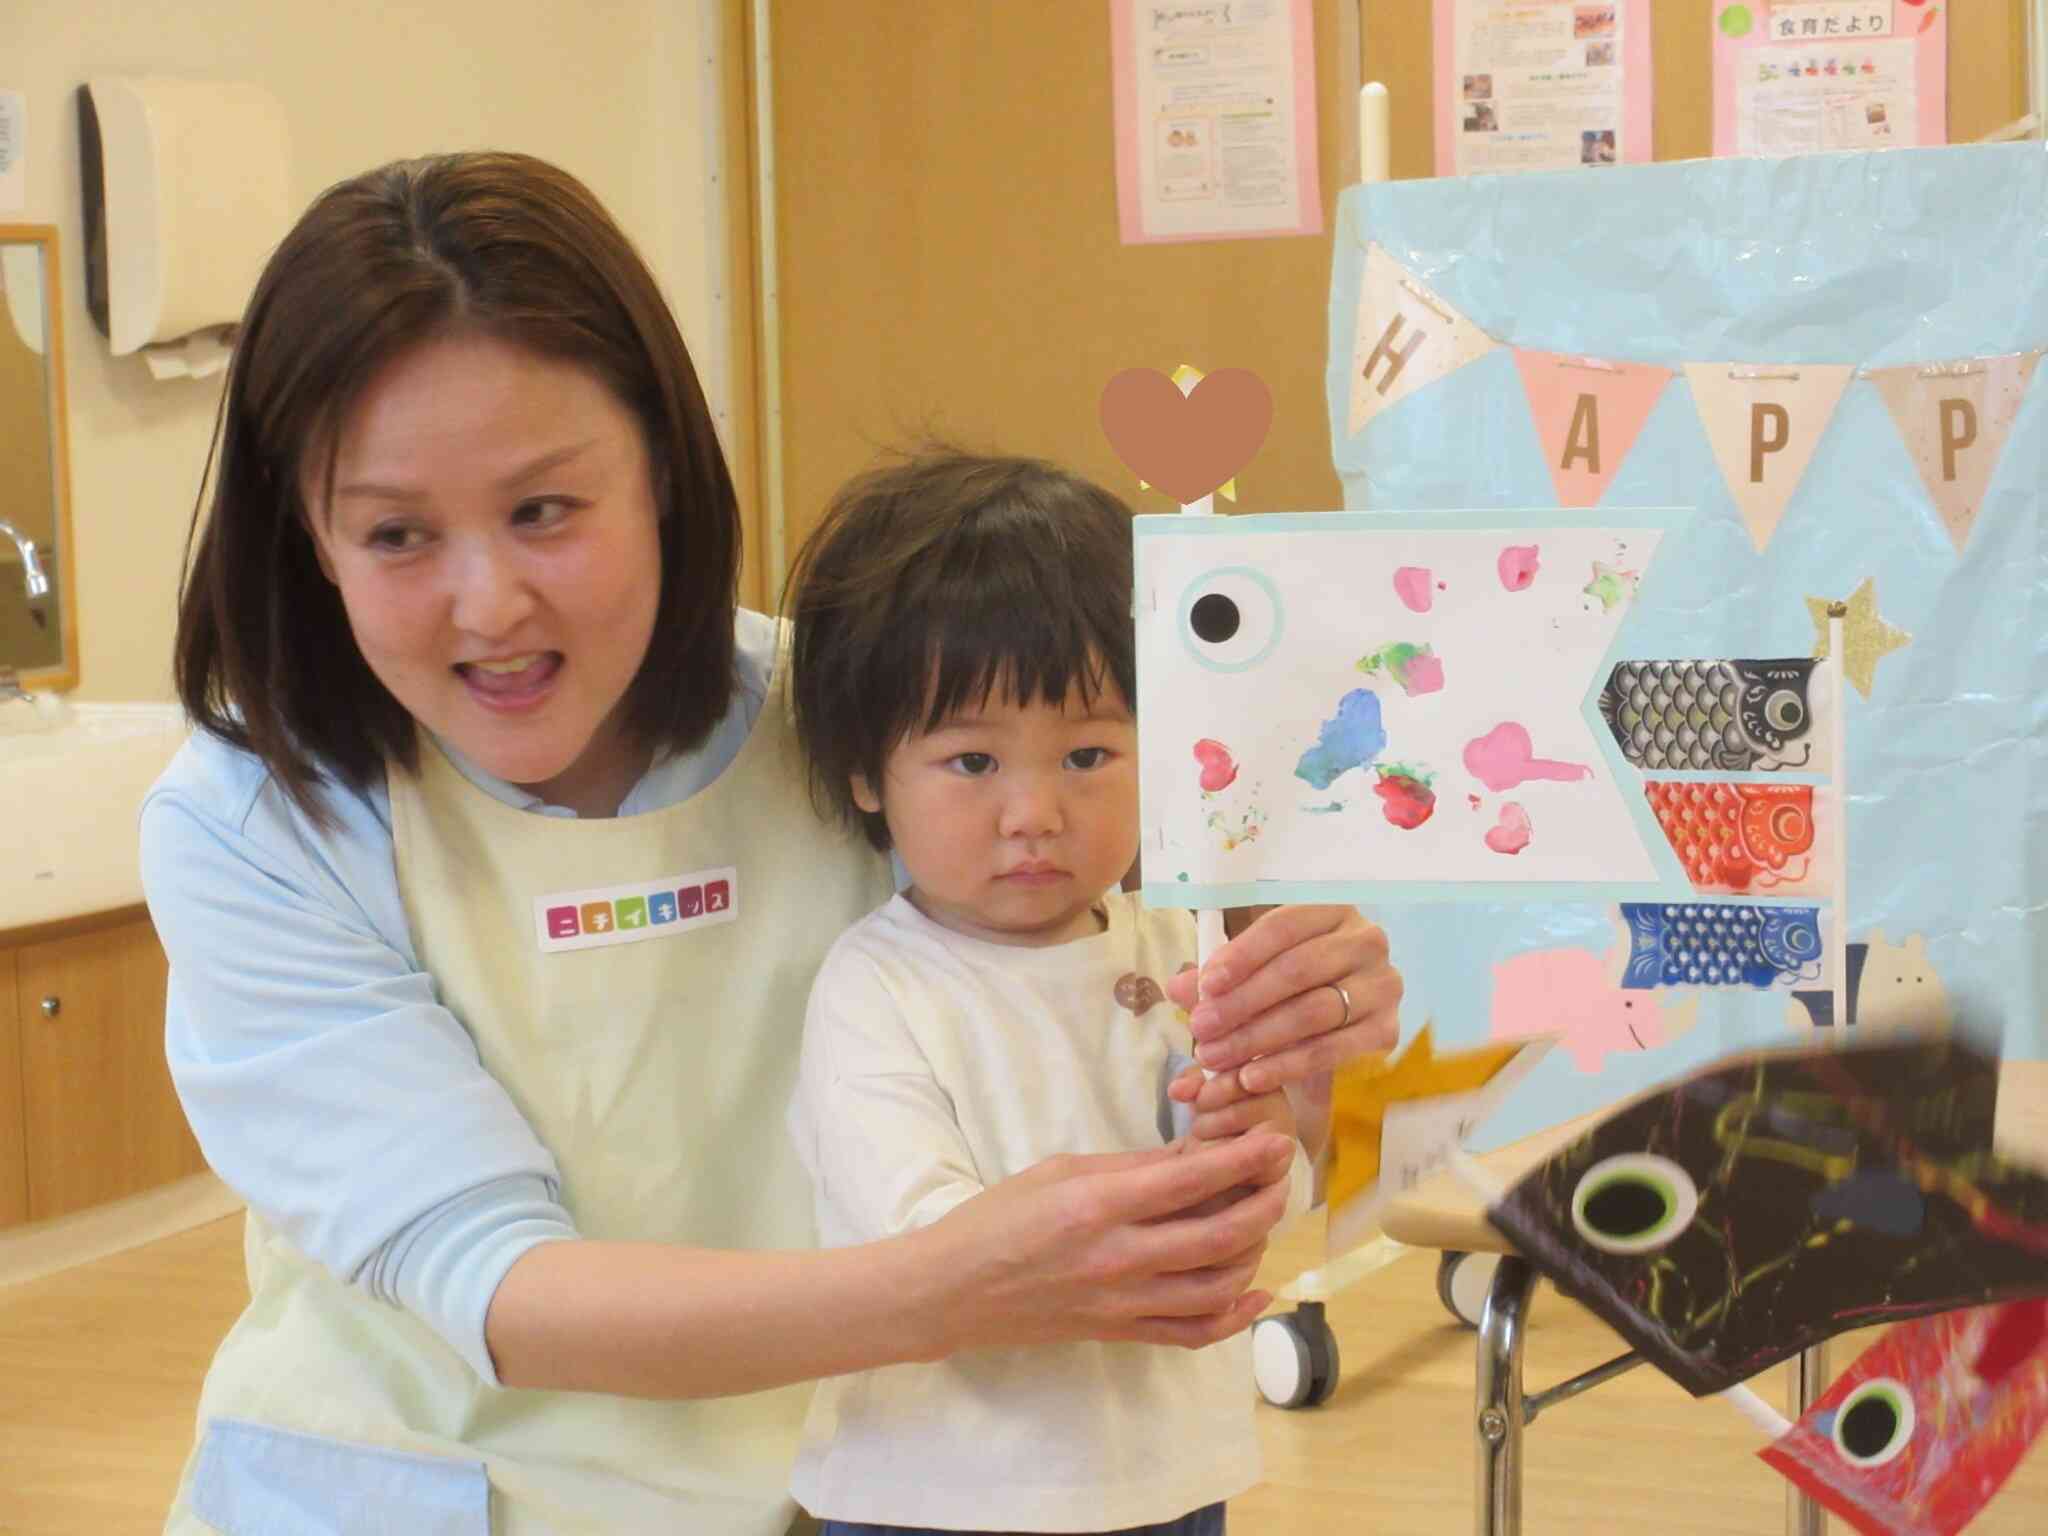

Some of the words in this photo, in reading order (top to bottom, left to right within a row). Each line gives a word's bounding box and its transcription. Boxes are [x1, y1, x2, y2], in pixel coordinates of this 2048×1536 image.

[1779, 15, 1884, 36] 食育だより
